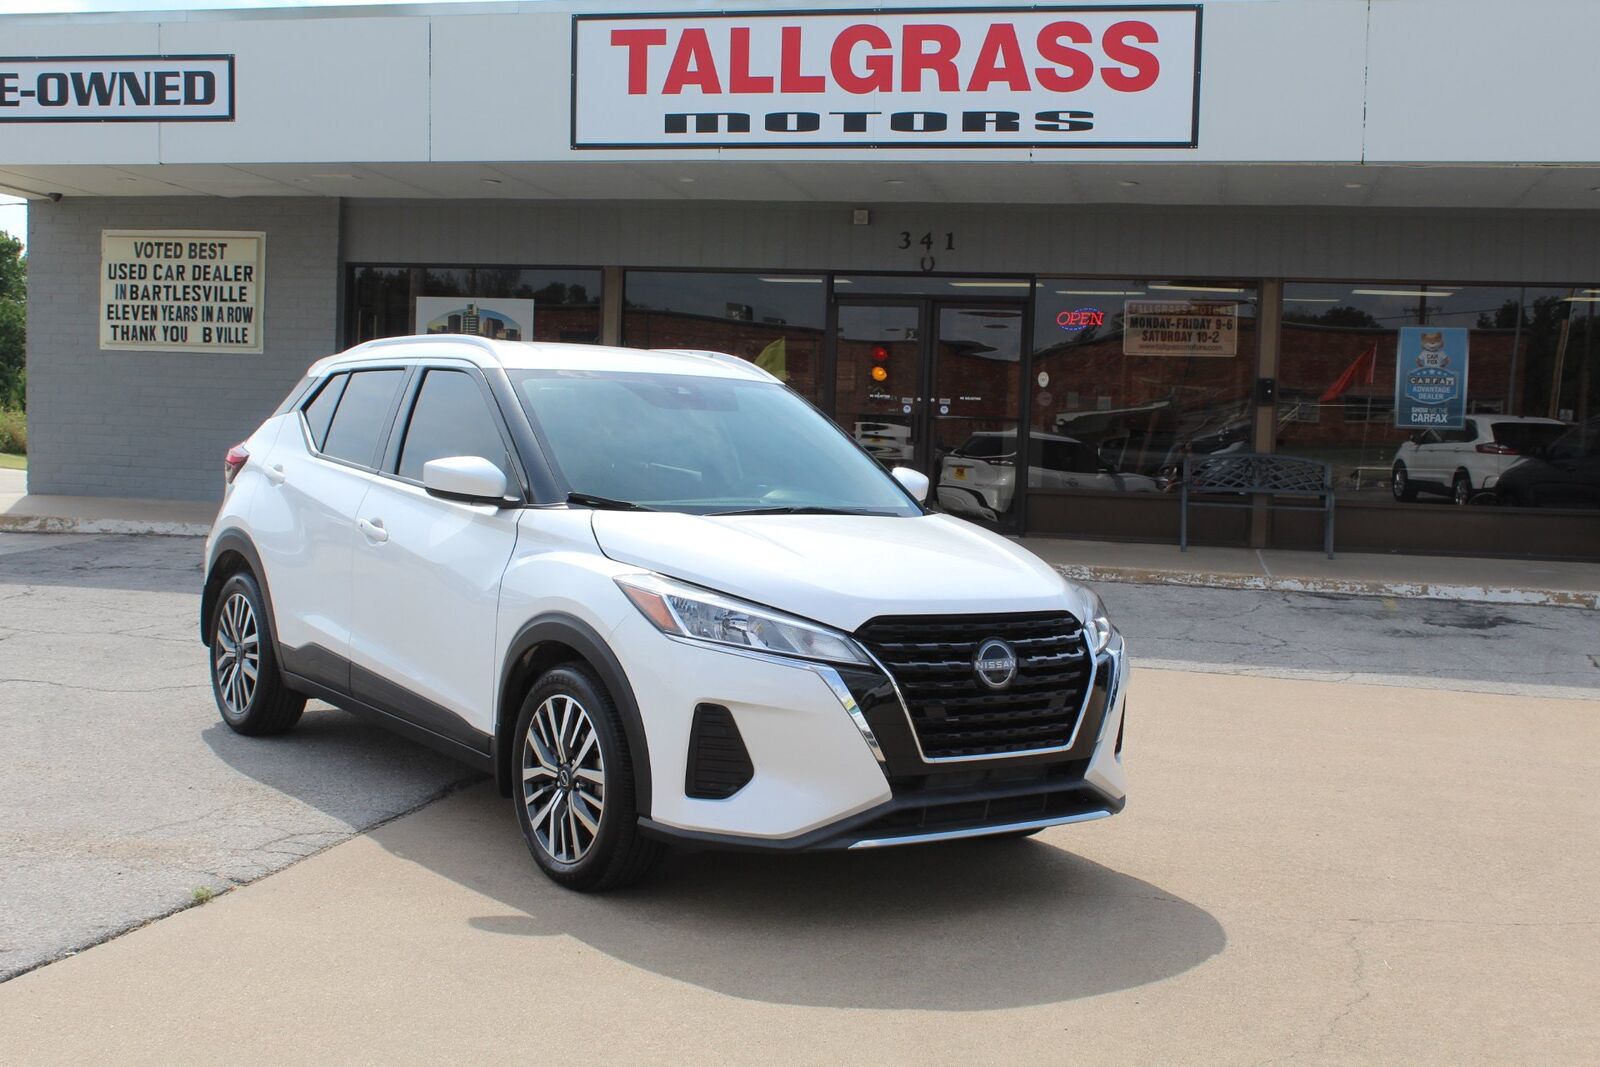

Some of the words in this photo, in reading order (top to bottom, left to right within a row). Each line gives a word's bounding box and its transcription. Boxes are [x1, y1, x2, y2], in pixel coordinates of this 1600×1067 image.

[610, 20, 1160, 95] TALLGRASS
[664, 110, 1094, 134] MOTORS
[134, 241, 183, 258] VOTED
[188, 242, 227, 260] BEST
[108, 263, 147, 280] USED
[153, 264, 185, 281] CAR
[192, 265, 253, 282] DEALER
[115, 284, 127, 300] IN
[129, 285, 247, 302] BARTLESVILLE
[107, 304, 158, 321] ELEVEN
[161, 305, 198, 322] YEARS
[201, 305, 213, 322] IN
[217, 307, 224, 322] A
[227, 307, 253, 323] ROW
[1056, 311, 1104, 326] OPEN
[1130, 317, 1211, 330] MONDAY-FRIDAY
[110, 324, 156, 341] THANK
[162, 326, 188, 342] YOU
[203, 327, 212, 343] B
[216, 327, 248, 343] VILLE
[1142, 330, 1193, 342] SATURDAY
[1197, 331, 1219, 343] 10-2
[1410, 377, 1455, 385] CARFAX
[1411, 413, 1448, 423] CARFAX
[975, 659, 1016, 669] NISSAN
